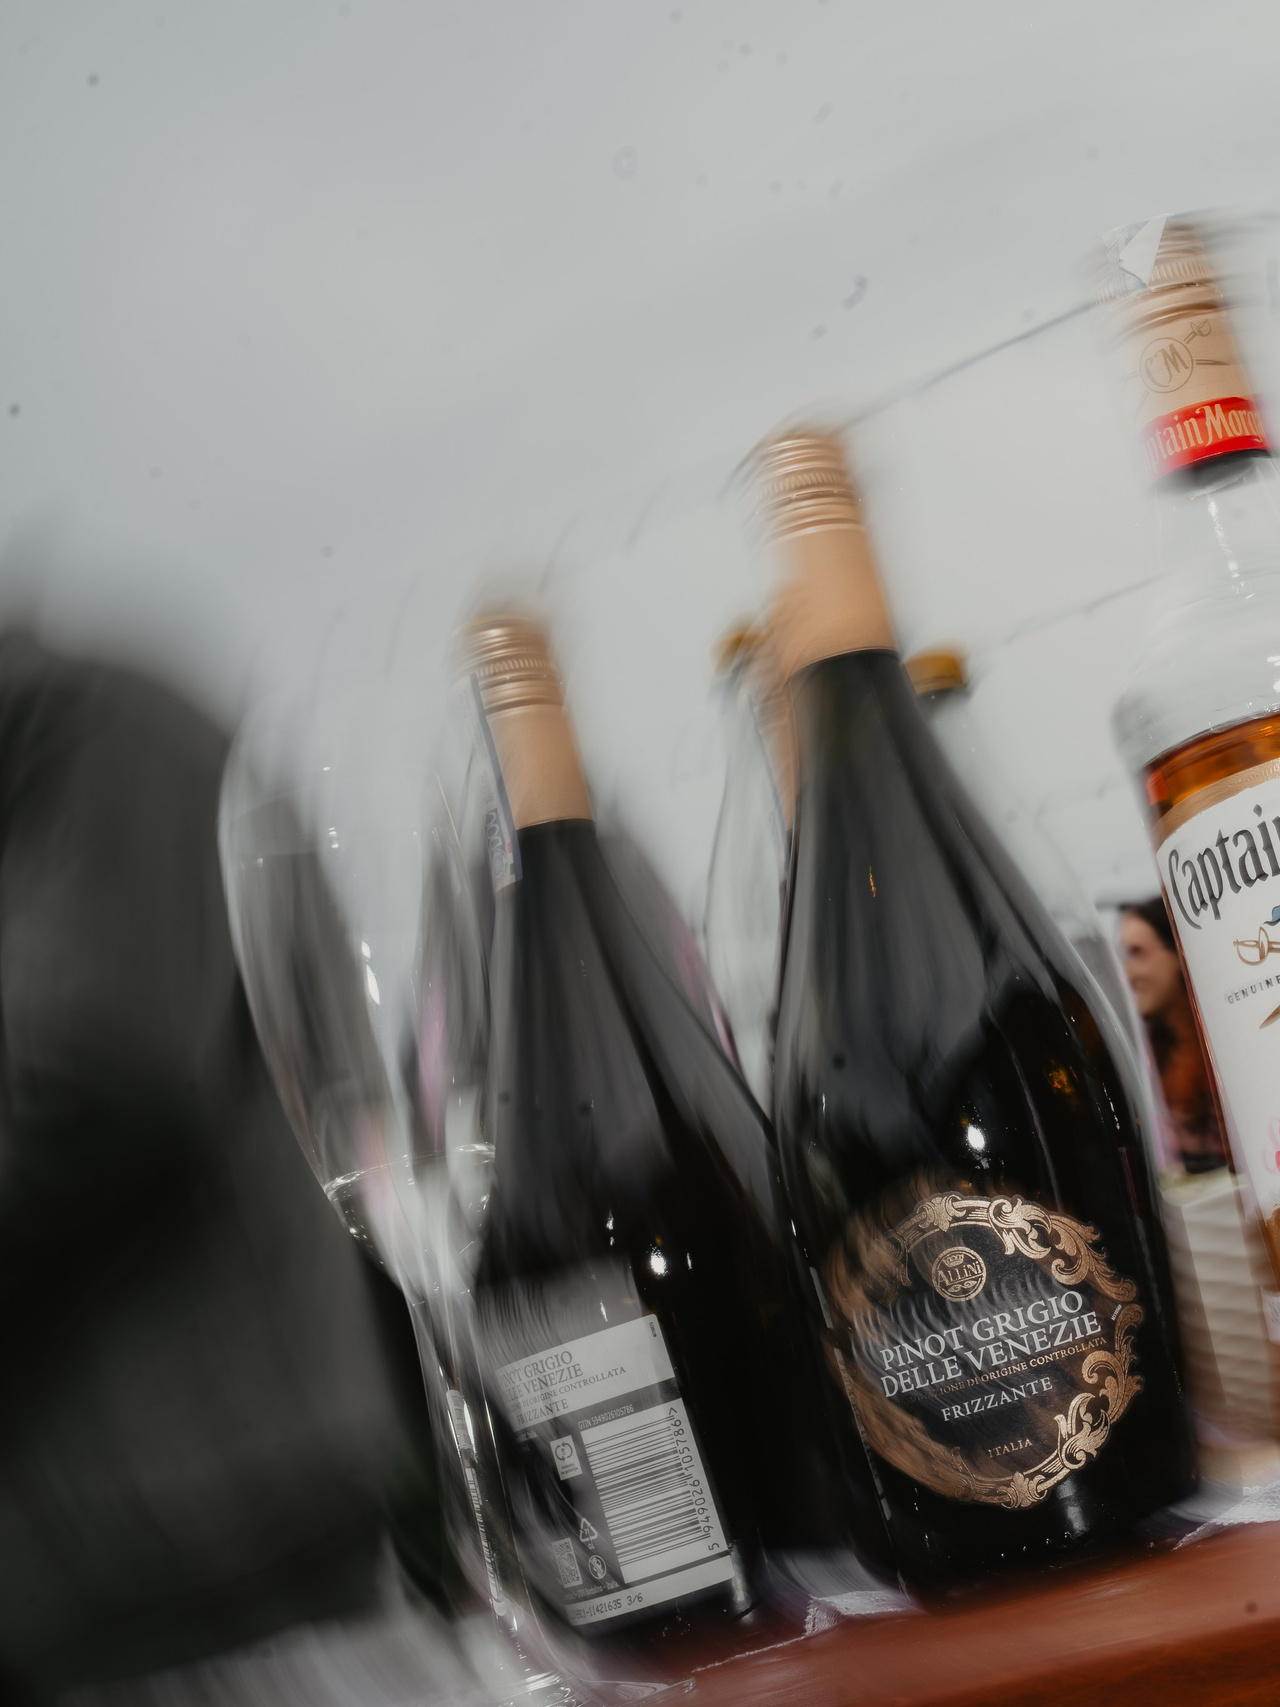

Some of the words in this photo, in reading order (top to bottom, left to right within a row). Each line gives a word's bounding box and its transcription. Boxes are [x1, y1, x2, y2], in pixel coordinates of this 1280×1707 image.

[879, 1327, 964, 1368] PINOT
[972, 1290, 1084, 1342] GRIGIO
[522, 1351, 572, 1378] GRIGIO
[880, 1357, 962, 1398] DELLE
[963, 1312, 1102, 1371] VENEZIE
[981, 1361, 1028, 1383] ORIGINE
[1029, 1336, 1106, 1367] CONTROLLATA
[522, 1364, 583, 1393] VENEZIE
[559, 1366, 626, 1394] CONTROLLATA
[591, 1404, 634, 1425] 5949026105786
[941, 1377, 1053, 1421] FRIZZANTE
[673, 1418, 694, 1471] 105786
[988, 1438, 1032, 1458] ITALIA
[689, 1478, 713, 1532] 949026
[708, 1542, 719, 1550] 5
